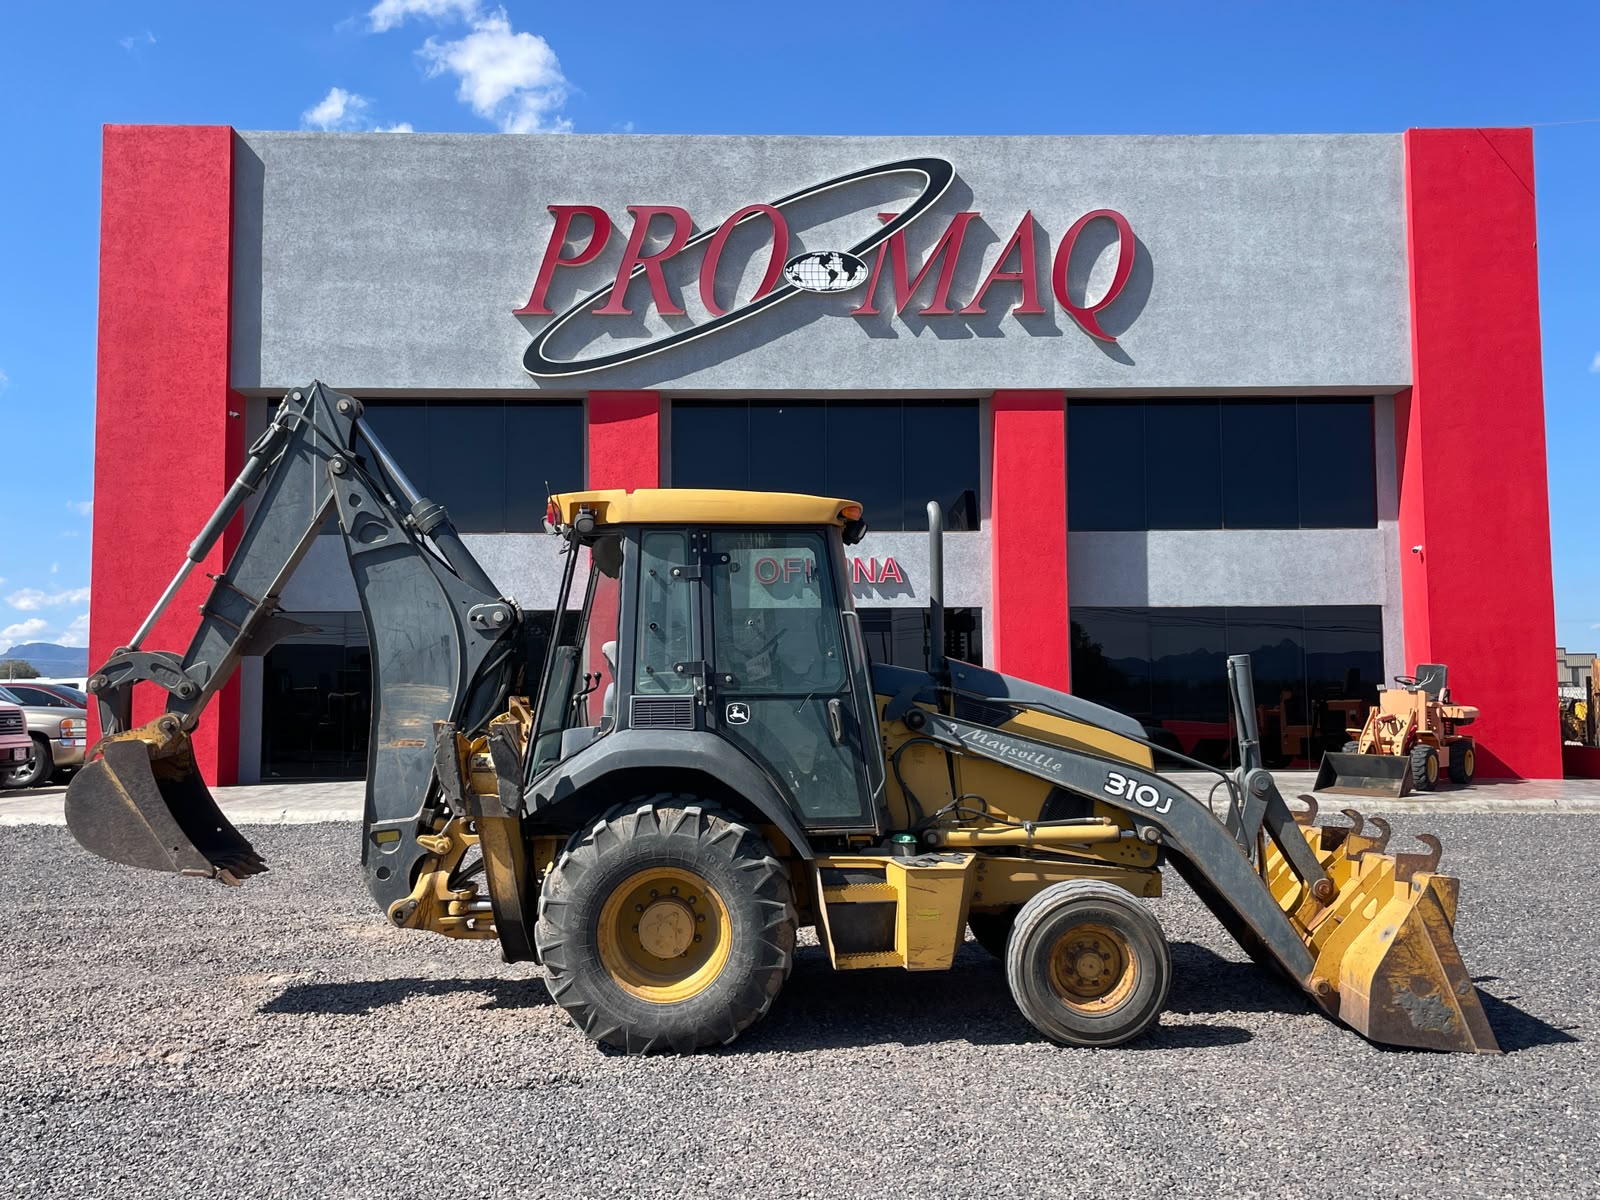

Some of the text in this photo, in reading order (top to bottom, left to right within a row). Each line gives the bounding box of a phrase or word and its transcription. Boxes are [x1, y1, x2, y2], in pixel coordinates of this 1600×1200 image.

[512, 203, 1136, 342] PRO MAQ
[754, 556, 903, 585] OFINA
[959, 729, 1063, 773] Maysville
[1103, 771, 1174, 815] 310J
